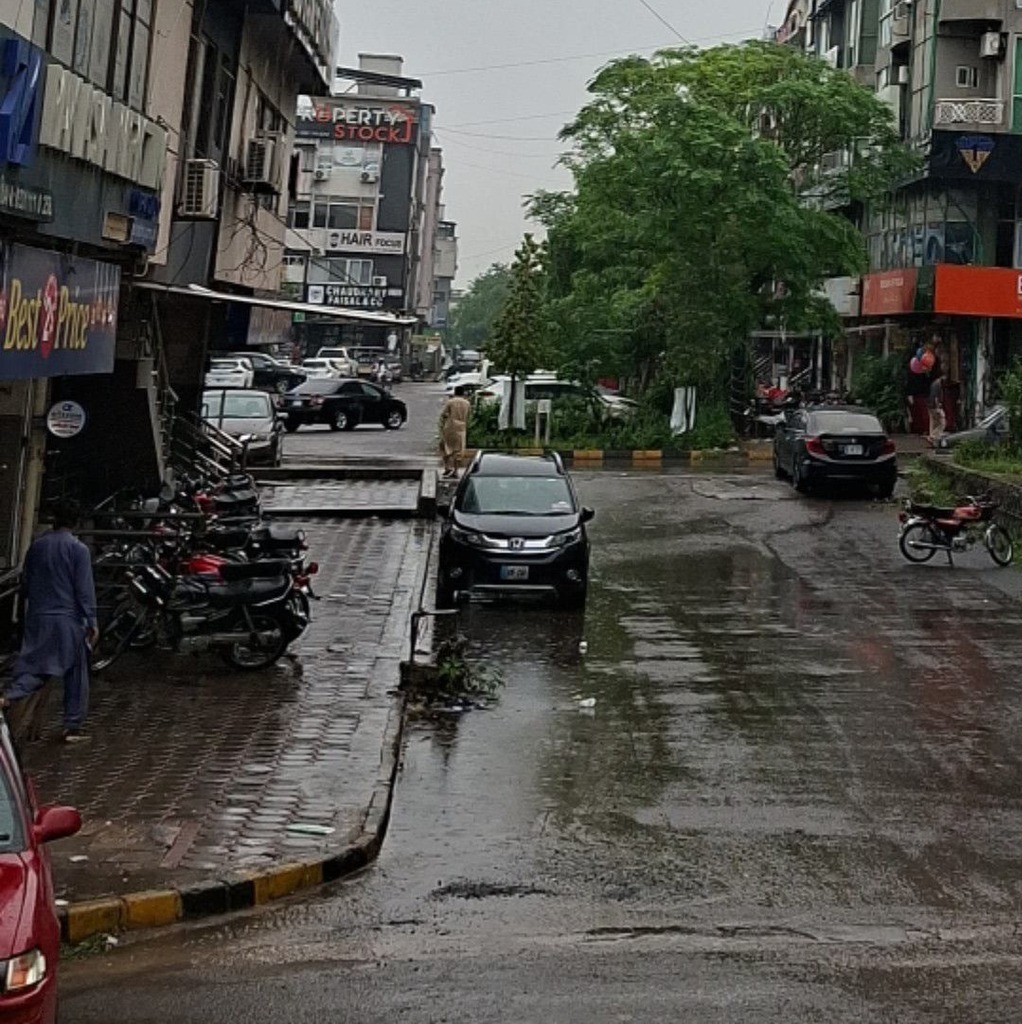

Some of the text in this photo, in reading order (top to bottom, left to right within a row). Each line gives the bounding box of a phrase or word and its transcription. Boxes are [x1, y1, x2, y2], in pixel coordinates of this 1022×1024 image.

[334, 124, 401, 143] STOCK
[341, 232, 373, 247] HAIR
[3, 277, 42, 350] Best
[54, 285, 90, 350] Price
